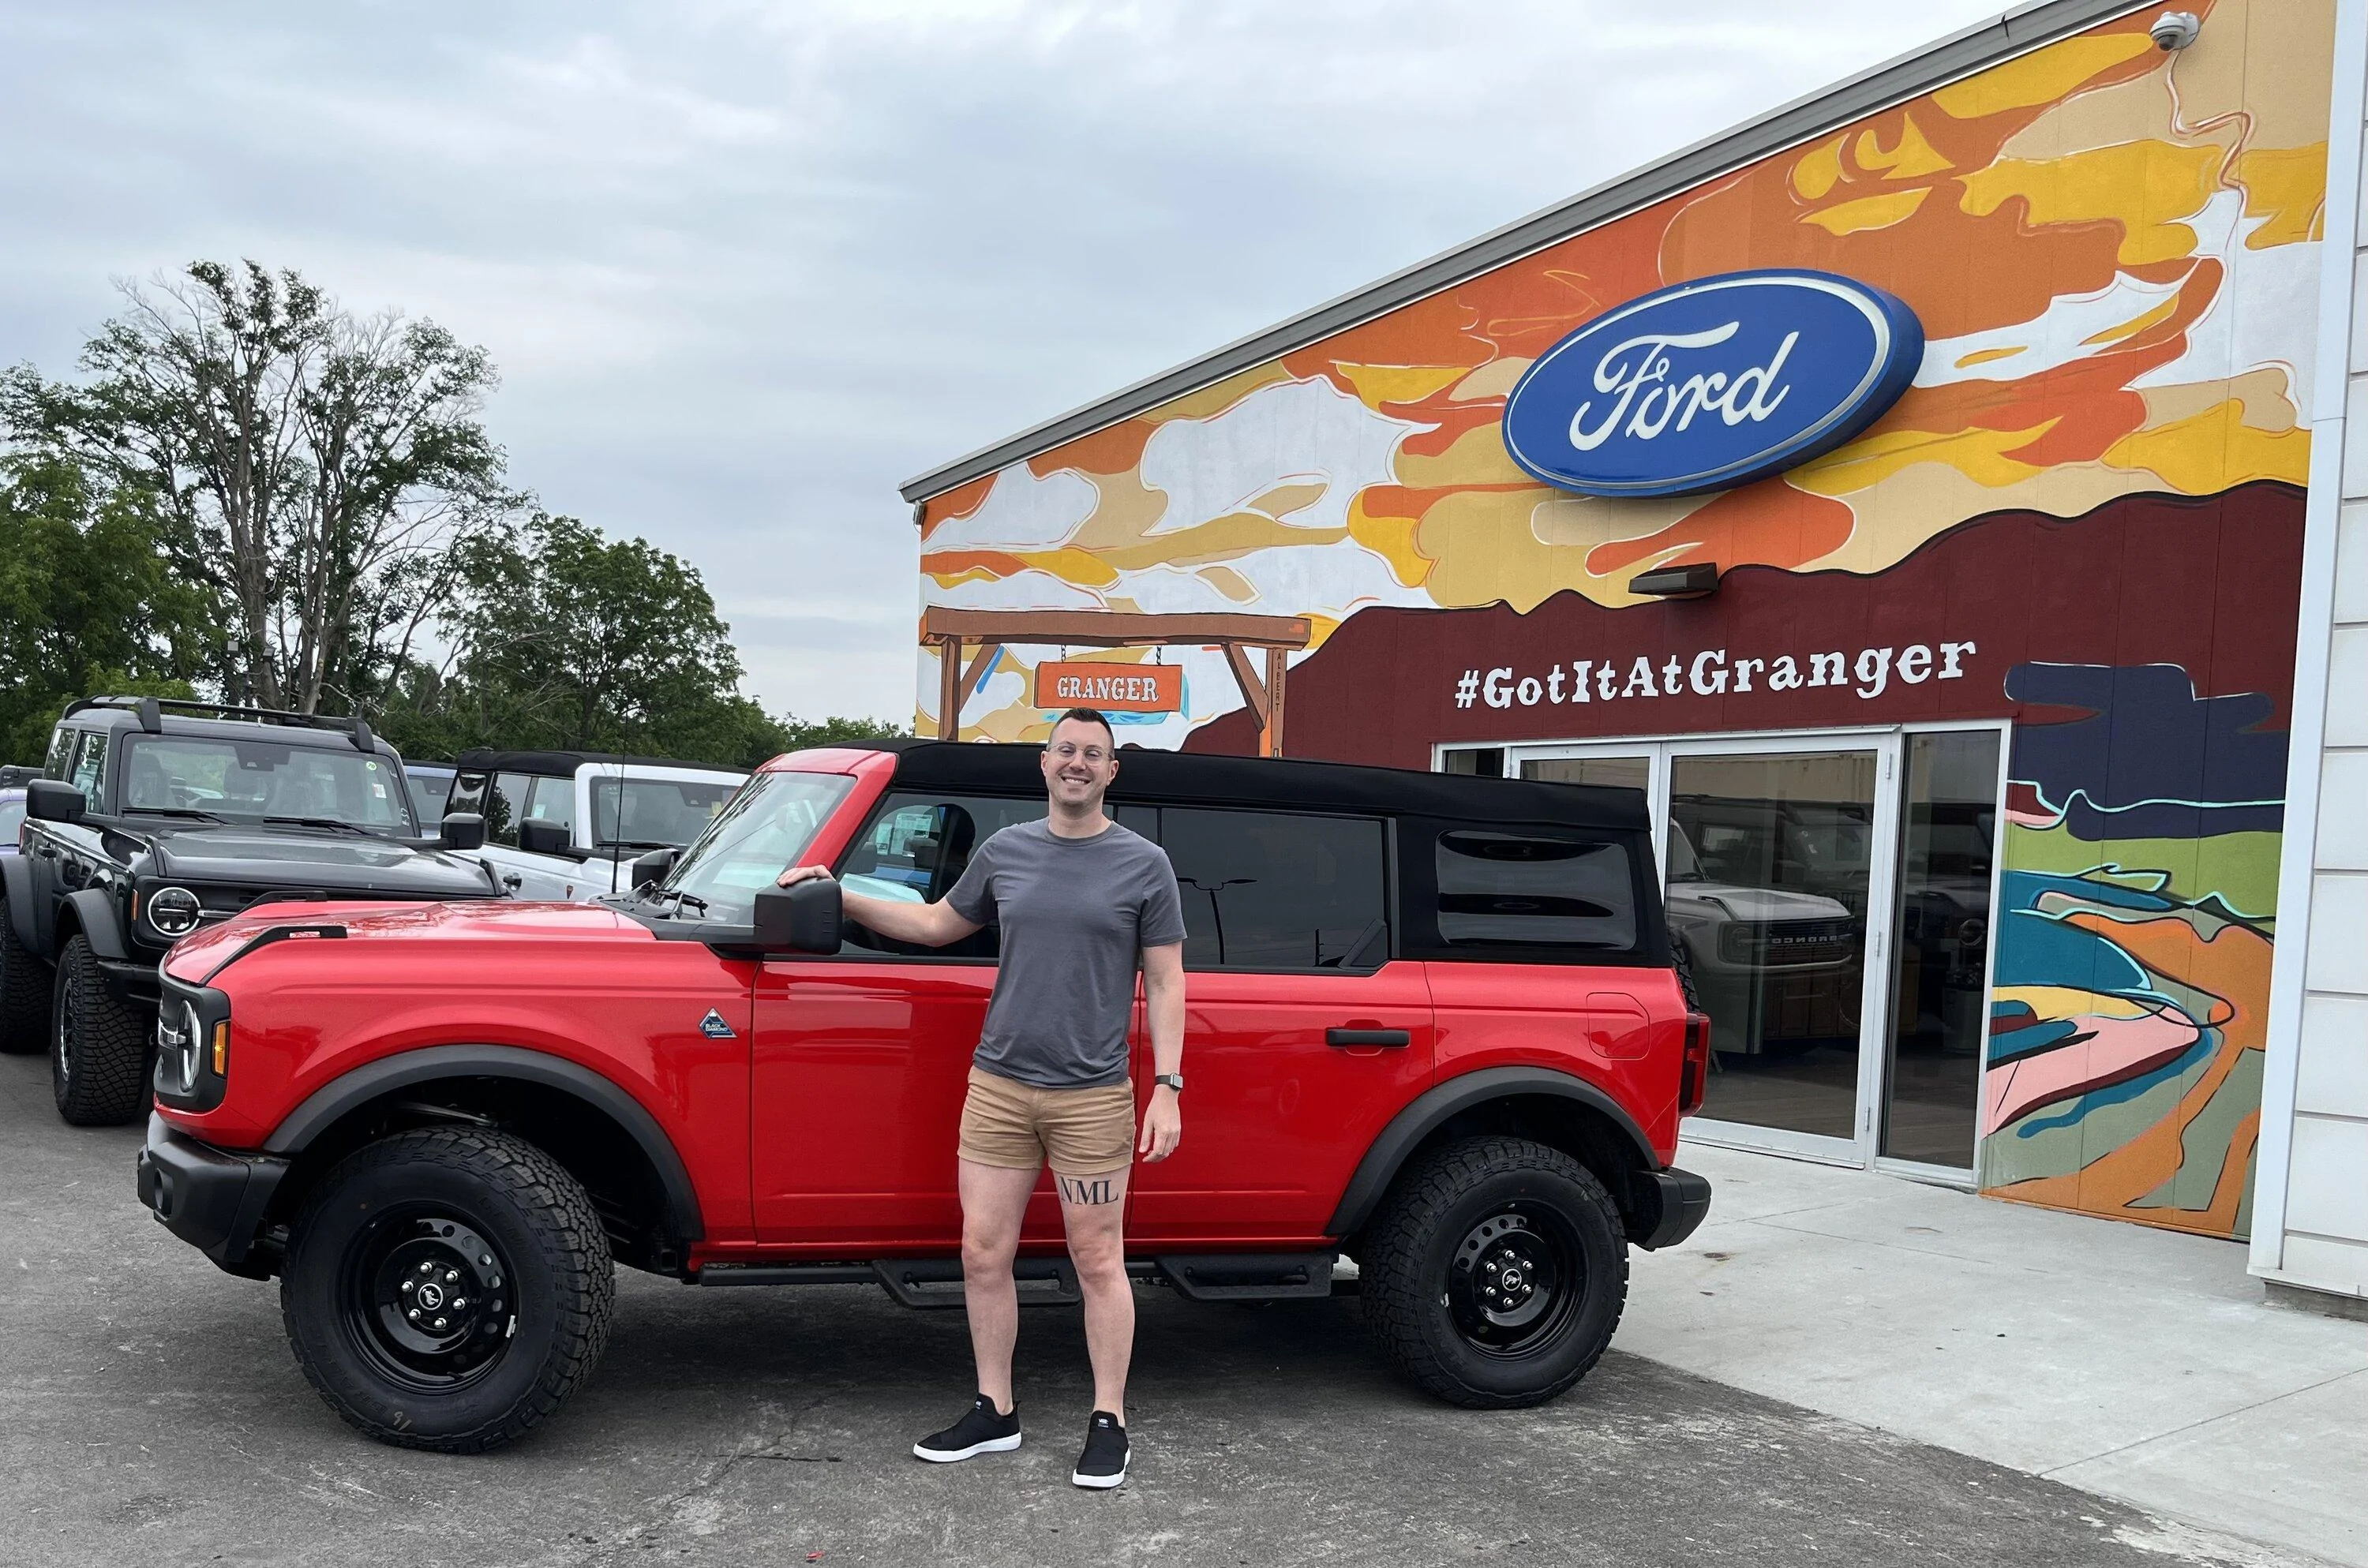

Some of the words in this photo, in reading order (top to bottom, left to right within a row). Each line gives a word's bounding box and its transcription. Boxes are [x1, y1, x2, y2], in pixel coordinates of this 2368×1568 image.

[1568, 321, 1800, 451] Ford
[1056, 676, 1160, 702] GRANGER
[1455, 640, 1976, 709] #GotItAtGranger
[1059, 1176, 1119, 1206] NML
